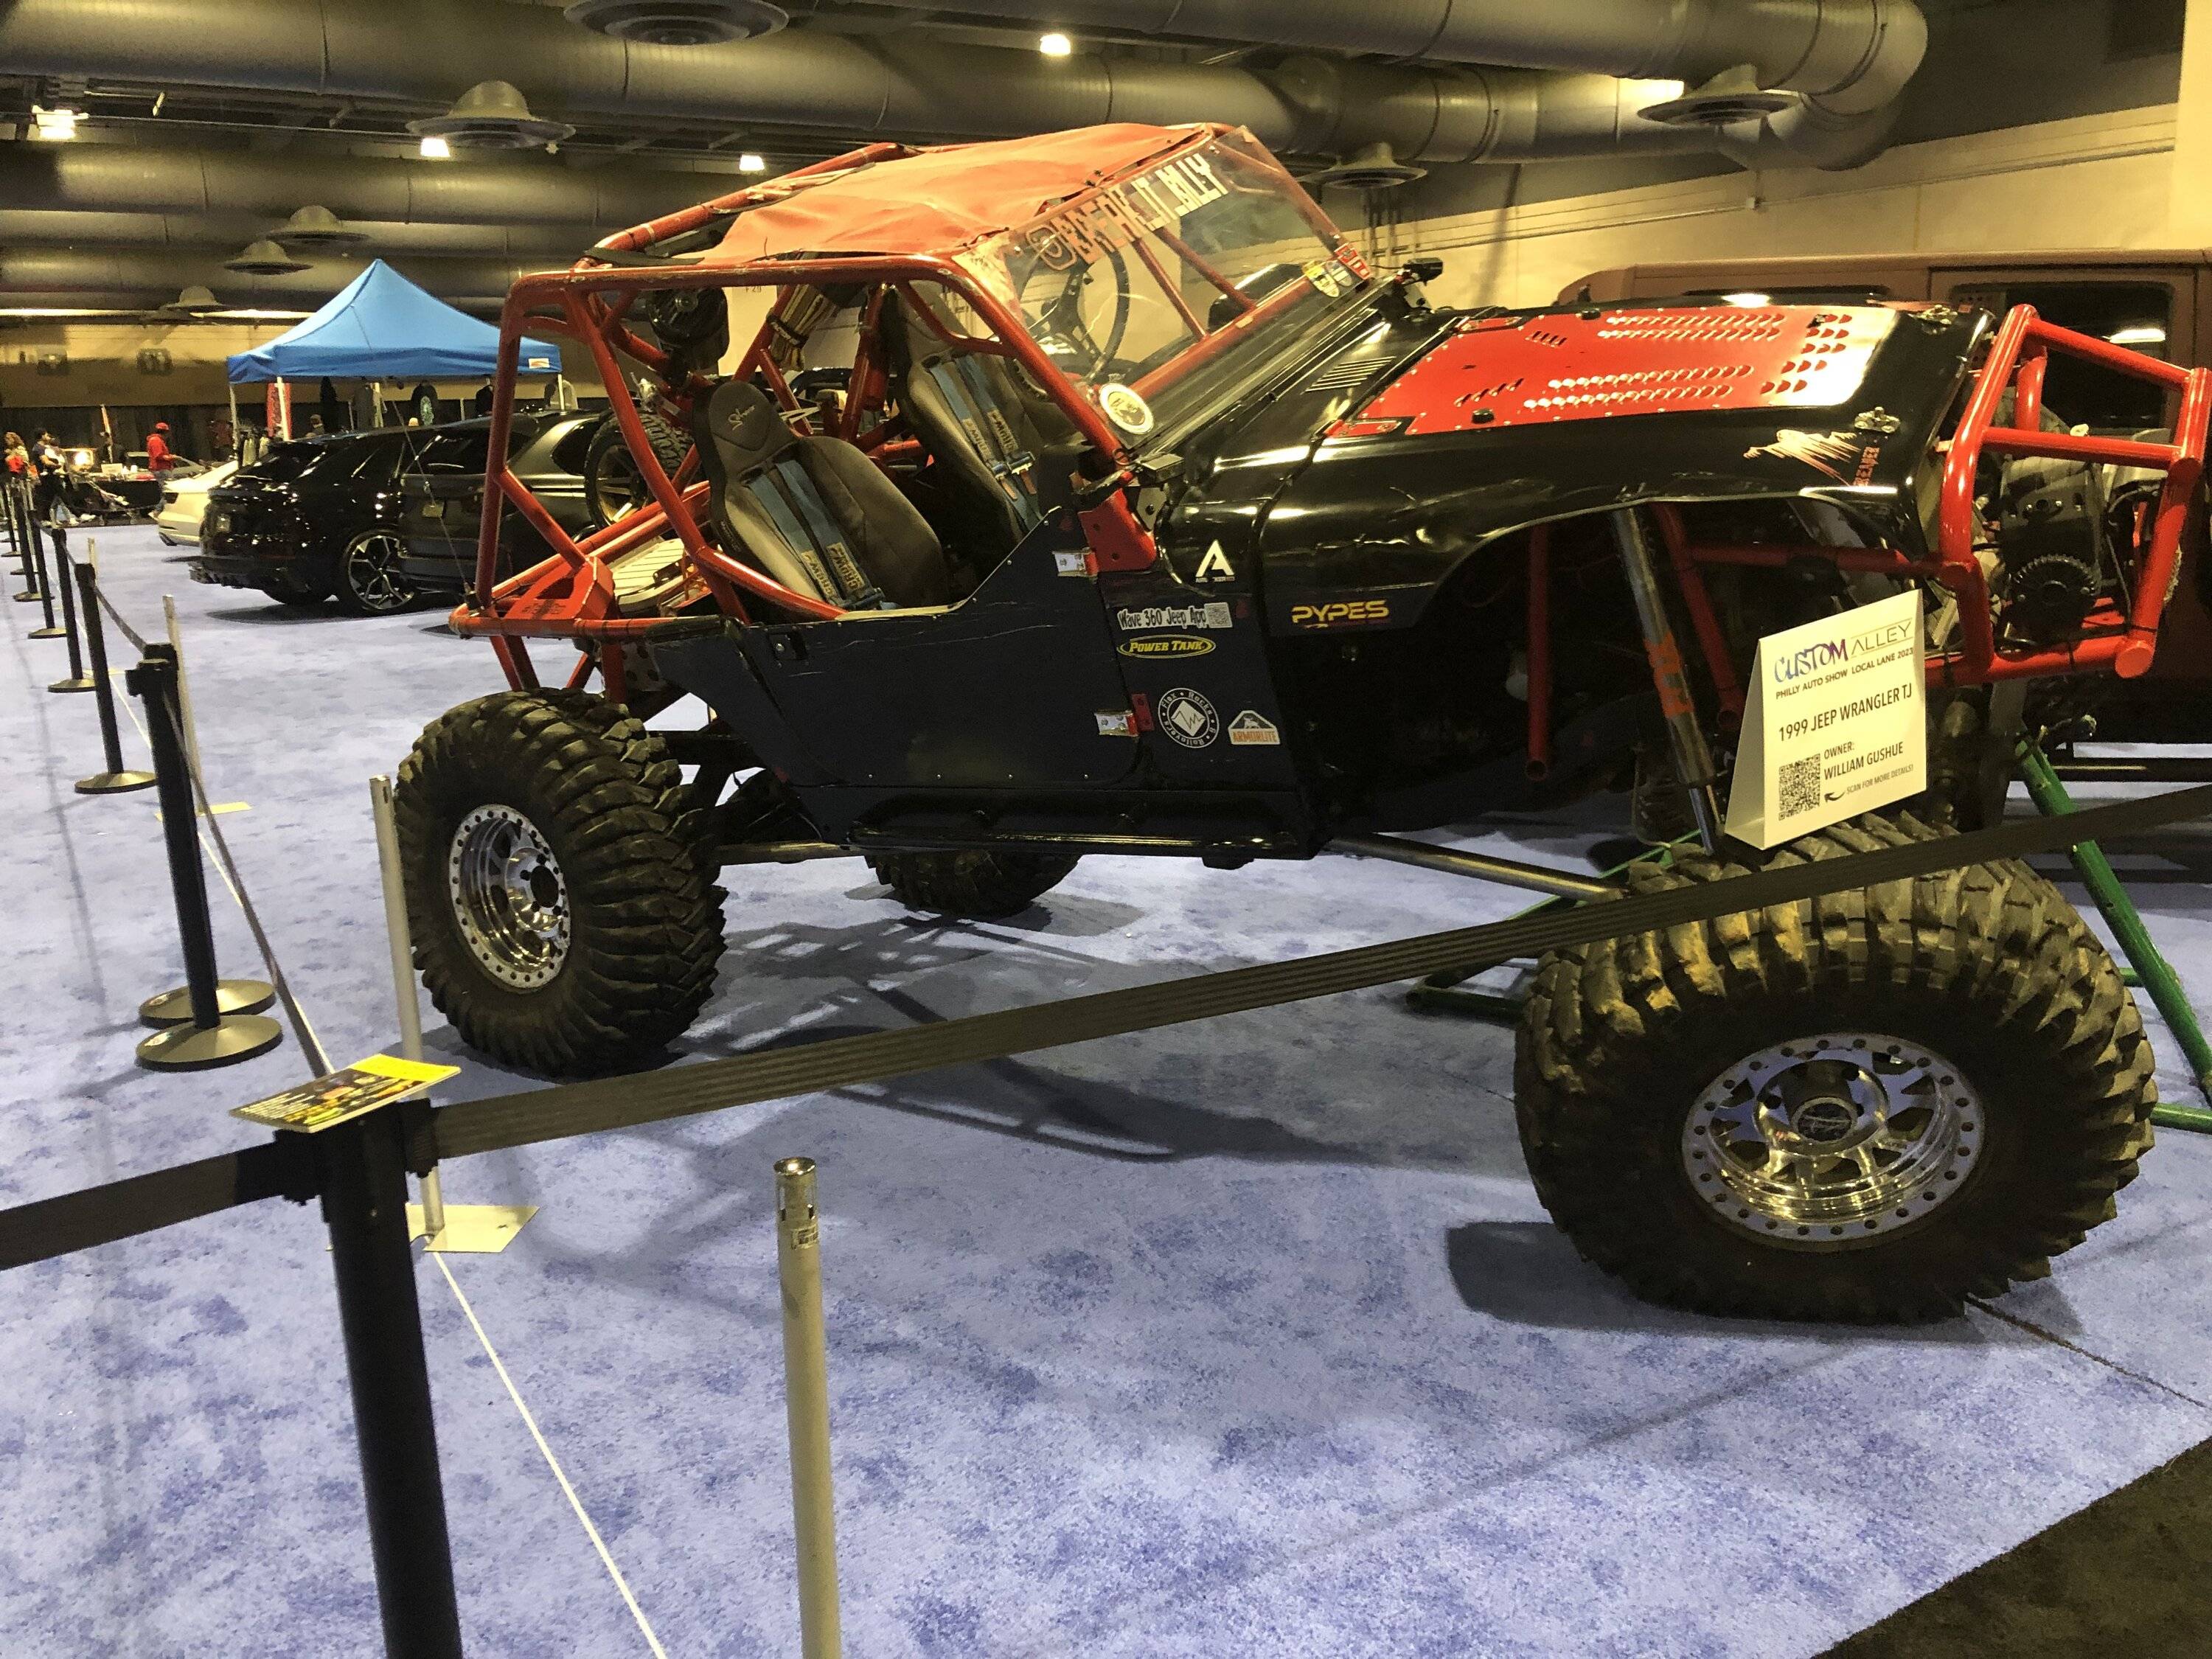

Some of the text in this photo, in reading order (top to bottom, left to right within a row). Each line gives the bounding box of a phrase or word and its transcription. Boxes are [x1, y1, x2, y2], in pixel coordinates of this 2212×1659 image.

[1118, 606, 1207, 628] Wave 360 Jeep App
[1291, 599, 1390, 624] PYPES
[1129, 640, 1203, 653] POWER TANK
[1774, 621, 1912, 683] CUSTOM ALLEY
[1775, 647, 1914, 700] PHILLY AUTO SHOW LOCAL LANE 2023
[1161, 692, 1177, 709] Flex
[1778, 683, 1913, 742] 1999 JEEP WRANGLER TJ
[1231, 731, 1276, 742] ARMORLITE
[1823, 741, 1855, 759] OWNER:
[1823, 742, 1904, 781] WILLIAM GUSHUE
[1846, 764, 1914, 794] SCAN FOR MORE DETAILS!
